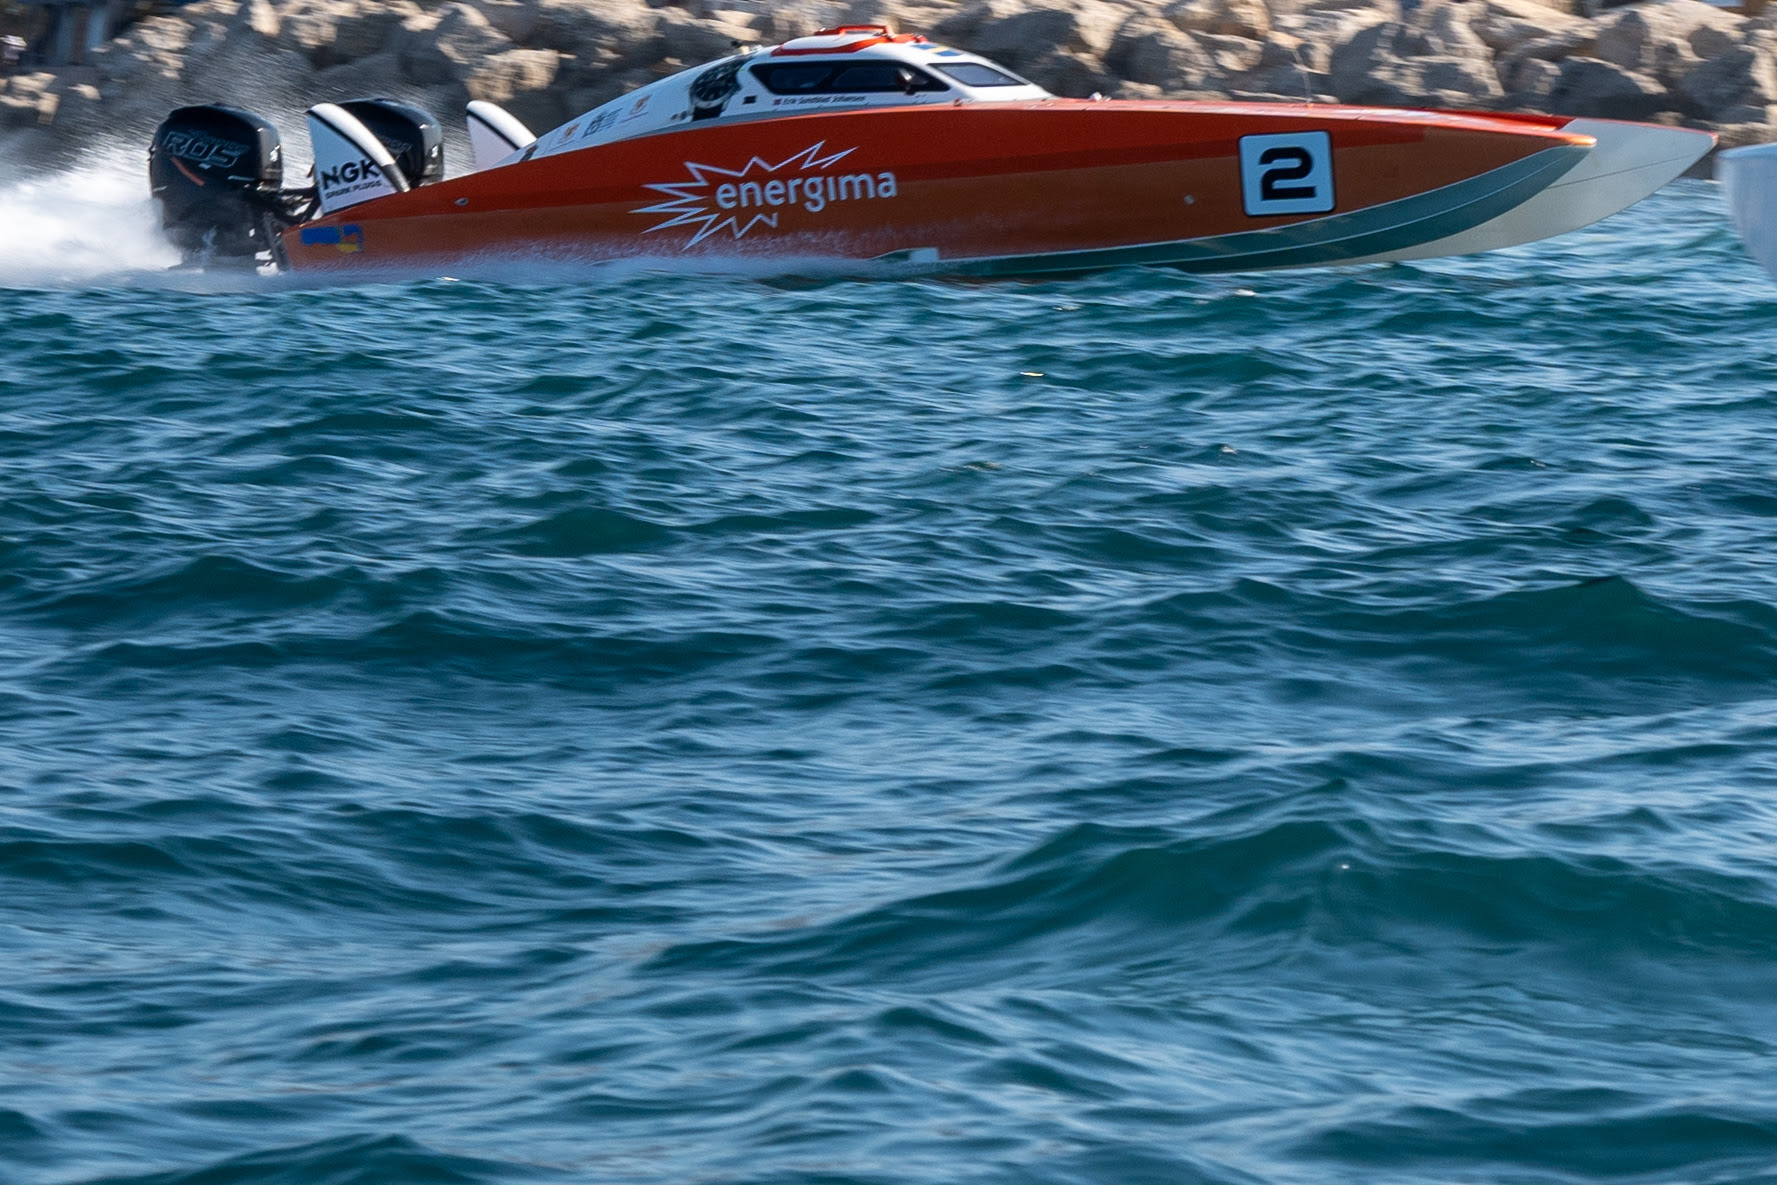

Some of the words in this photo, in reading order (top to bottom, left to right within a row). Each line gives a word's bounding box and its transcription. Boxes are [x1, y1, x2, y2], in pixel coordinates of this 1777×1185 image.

[321, 159, 380, 190] NGK
[715, 171, 897, 212] energima
[1258, 147, 1317, 201] 2
